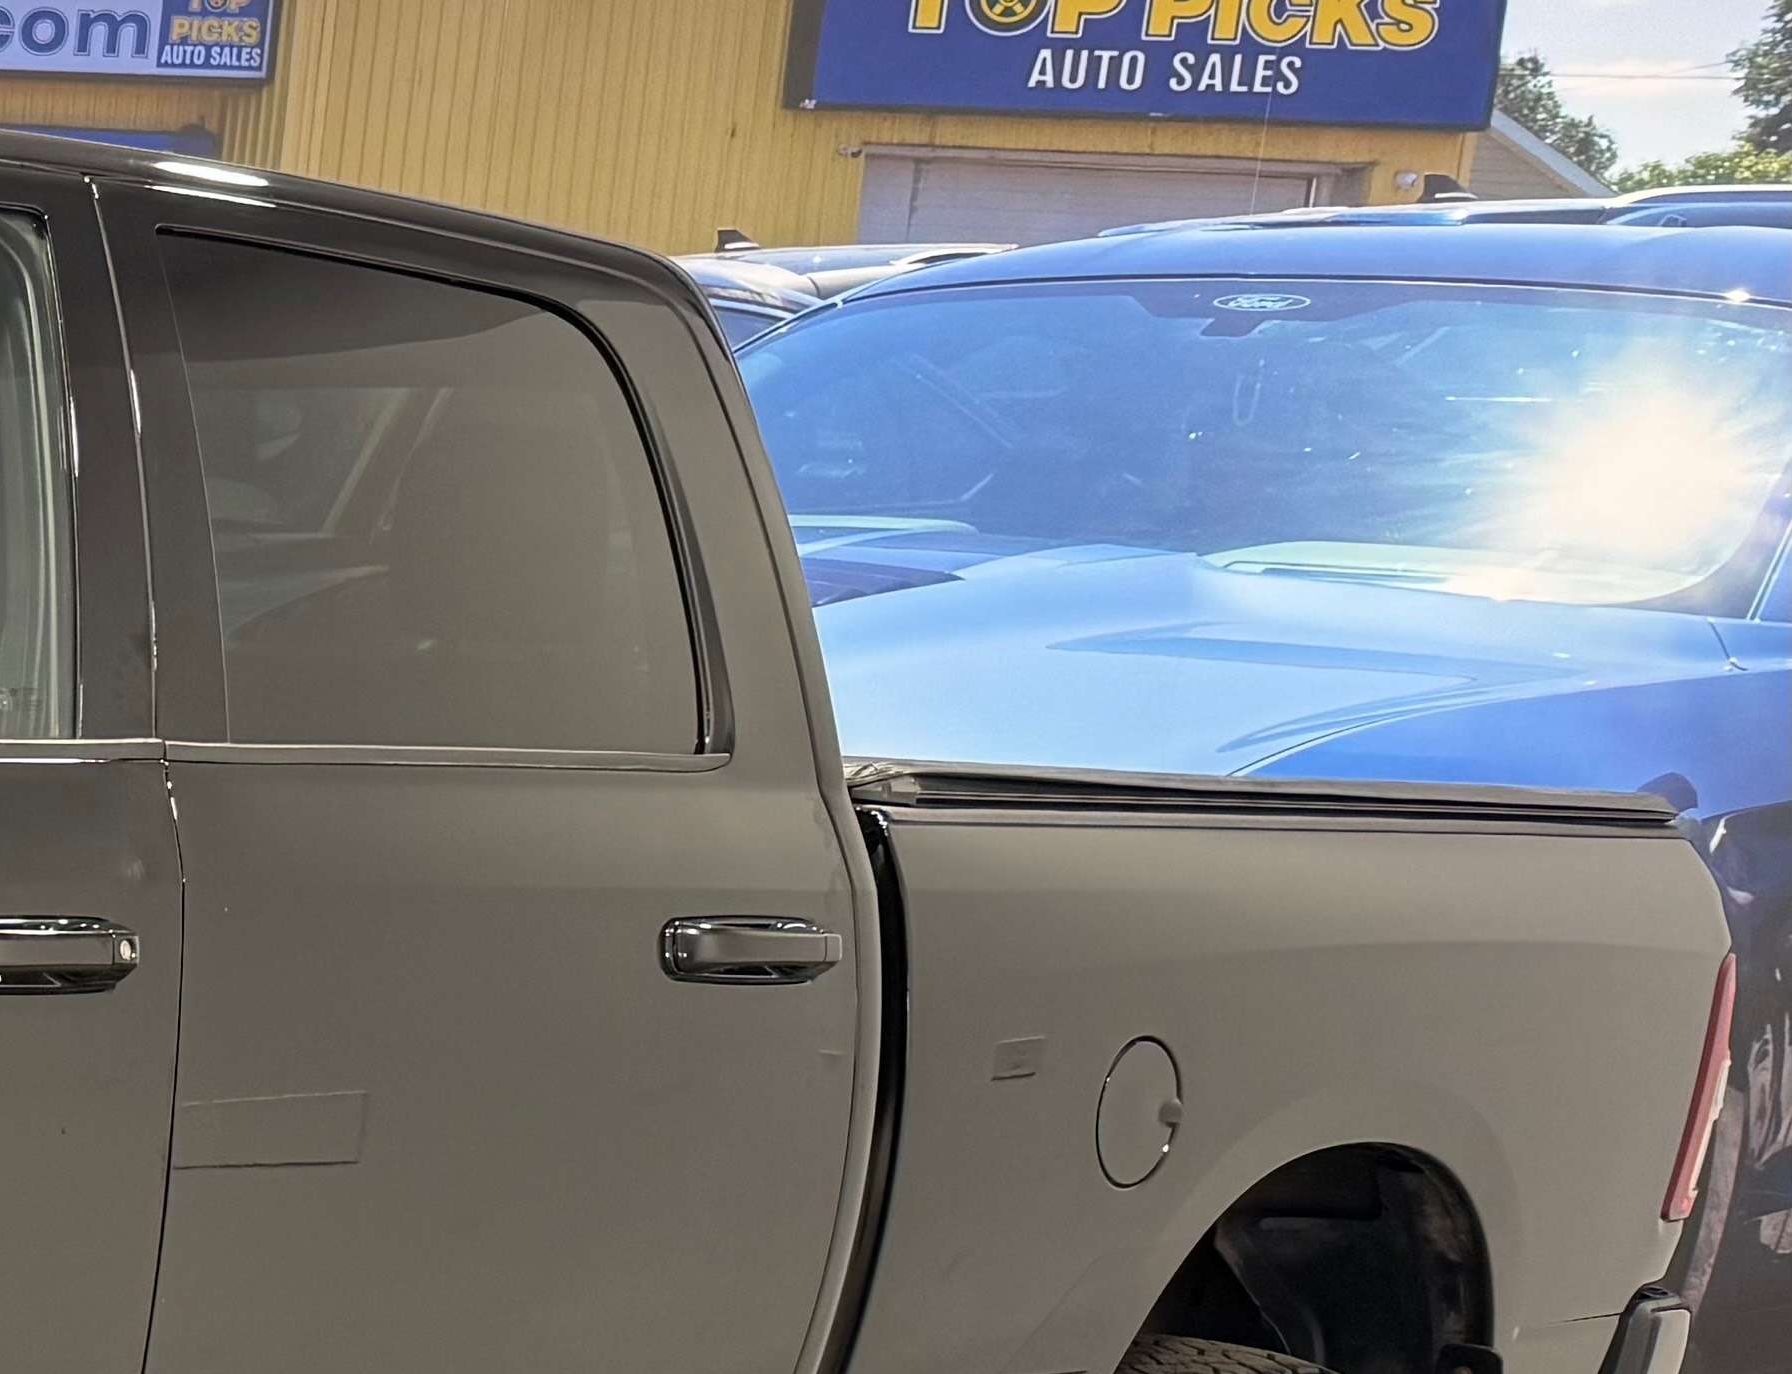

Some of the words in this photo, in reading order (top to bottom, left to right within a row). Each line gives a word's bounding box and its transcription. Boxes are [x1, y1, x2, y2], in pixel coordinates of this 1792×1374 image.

[169, 16, 260, 46] PICKS
[160, 45, 205, 65] AUTO
[209, 46, 261, 67] SALES
[1027, 48, 1146, 91] AUTO
[1169, 51, 1303, 96] SALES
